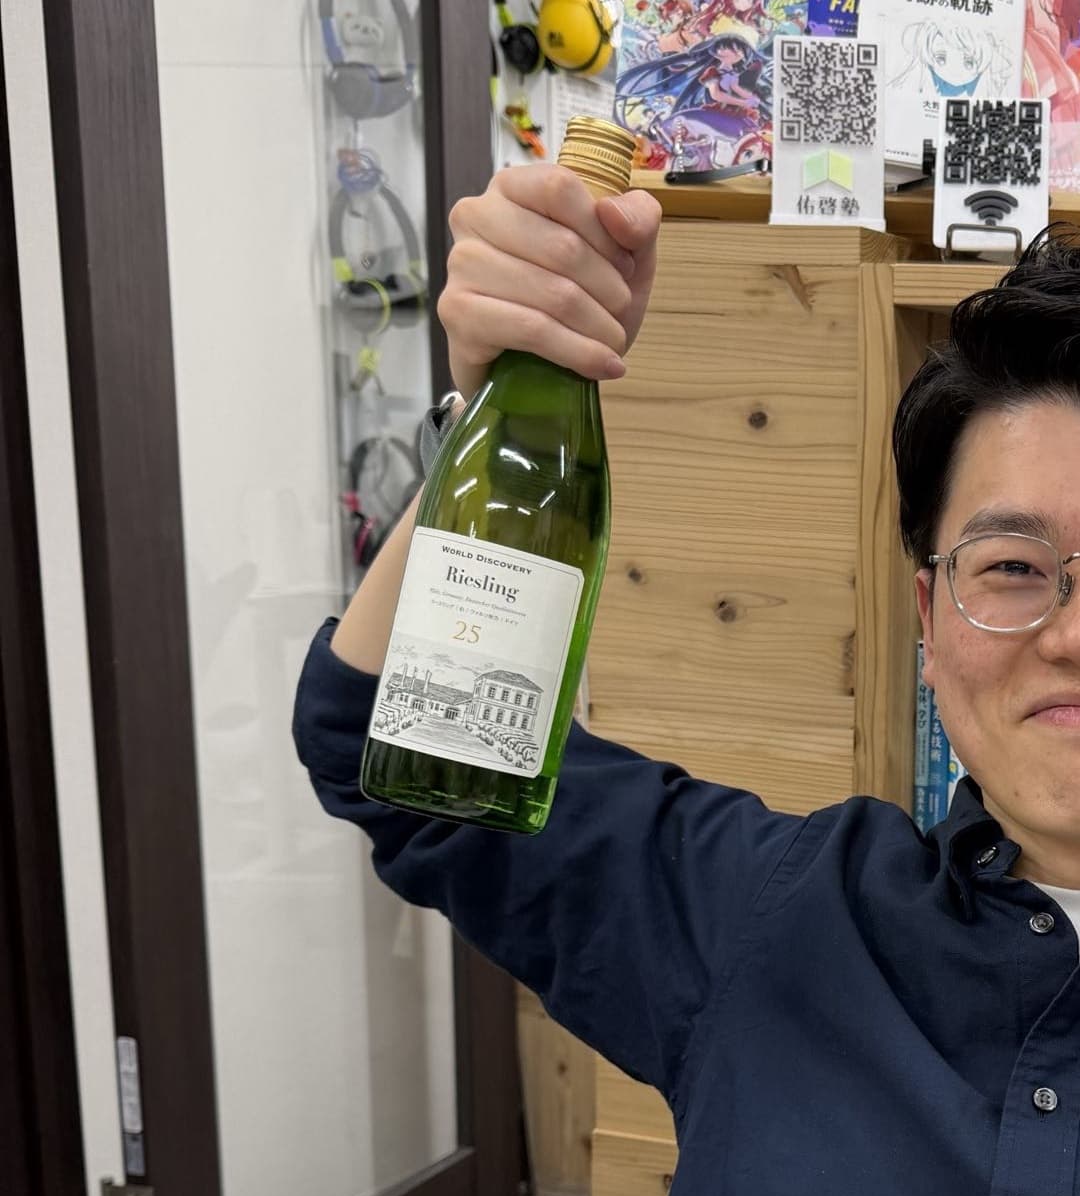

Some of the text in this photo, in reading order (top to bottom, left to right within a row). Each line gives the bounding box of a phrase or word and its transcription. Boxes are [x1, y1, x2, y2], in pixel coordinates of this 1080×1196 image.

[797, 195, 860, 215] 佑啓塾
[442, 545, 532, 575] WORLD DISCOVERY
[446, 565, 520, 604] Riesling
[453, 620, 482, 644] 25
